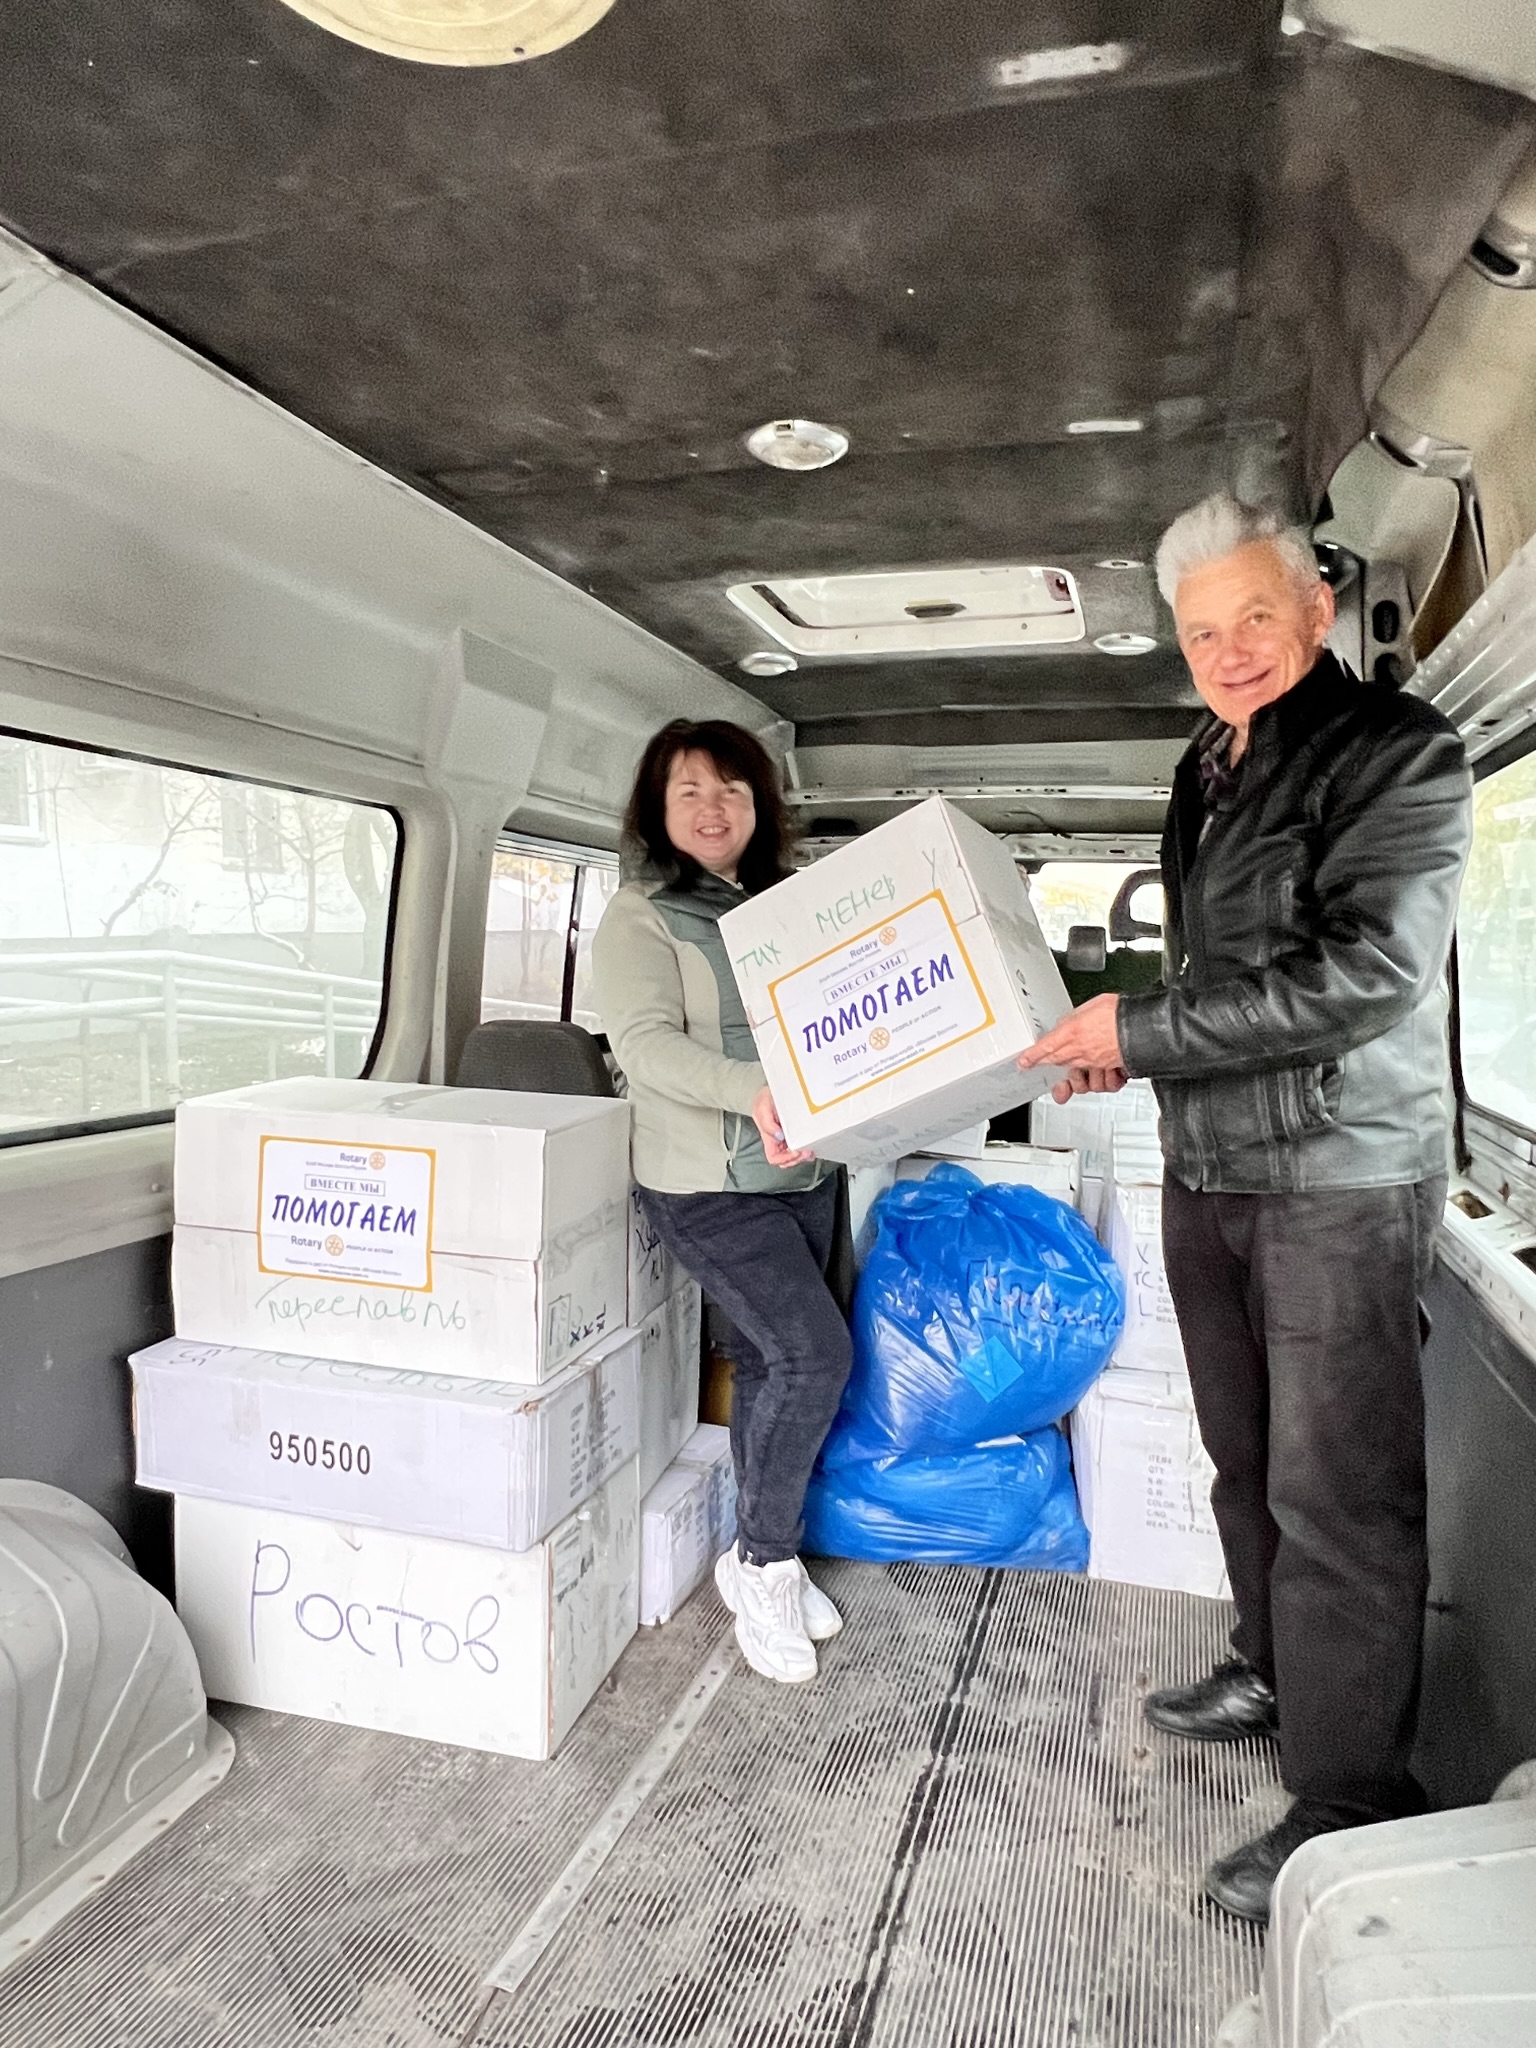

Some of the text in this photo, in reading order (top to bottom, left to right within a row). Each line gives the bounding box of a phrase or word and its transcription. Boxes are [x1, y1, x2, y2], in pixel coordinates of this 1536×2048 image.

[849, 939, 878, 958] Rotary
[829, 967, 878, 1000] ВМЕСТЕ
[879, 955, 902, 972] МЫ
[802, 952, 955, 1053] ПОМОГАЕМ
[833, 1042, 868, 1065] Rotary
[339, 1152, 368, 1165] Rotary
[310, 1178, 380, 1194] ВМЕСТЕ МЫ
[271, 1193, 417, 1237] ПОМОГАЕМ
[290, 1235, 323, 1250] Rotary
[269, 1430, 371, 1476] 950500
[249, 1538, 500, 1675] Ростов
